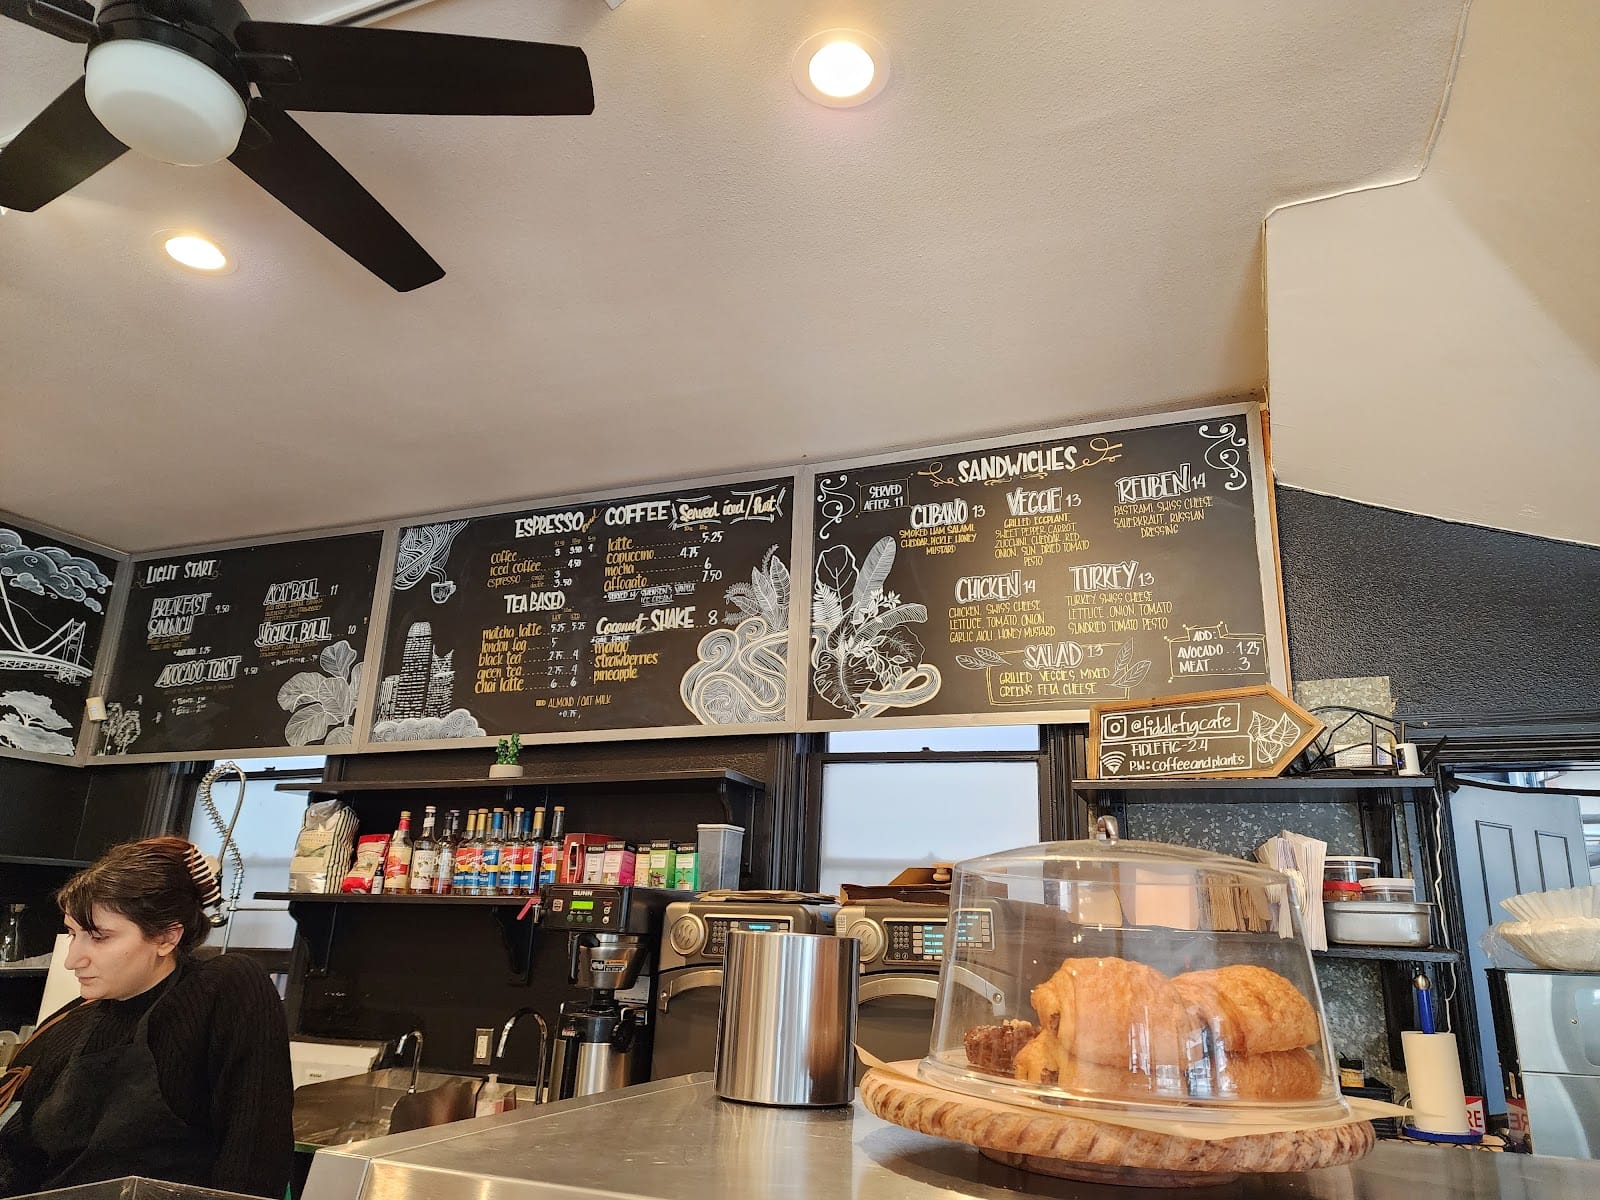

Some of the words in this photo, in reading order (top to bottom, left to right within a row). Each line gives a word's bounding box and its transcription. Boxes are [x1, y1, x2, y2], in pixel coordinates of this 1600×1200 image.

[957, 446, 1078, 484] SANDWICHES
[869, 484, 902, 499] SERVED
[1115, 463, 1191, 504] REUBEN
[1191, 472, 1206, 490] 14
[863, 498, 891, 511] AFTER
[894, 496, 904, 507] 11
[1006, 487, 1063, 516] VEGGIE
[1065, 493, 1082, 507] 13
[1156, 499, 1182, 512] SWISS
[1184, 496, 1214, 509] CHEESE
[605, 500, 671, 526] COFFEE
[678, 501, 721, 522] Served
[910, 498, 968, 529] CUBANO
[972, 504, 986, 518] 13
[1169, 509, 1205, 523] RUSSIAN
[515, 511, 585, 538] ESPRESSO
[1003, 517, 1032, 529] GRILLED
[1140, 524, 1179, 538] DRESSING
[899, 528, 928, 539] SMOKED
[929, 526, 946, 536] HAM
[930, 535, 952, 546] PICKLE
[955, 533, 977, 544] HONEY
[995, 528, 1019, 539] SWEET
[1065, 532, 1080, 542] RED
[588, 543, 594, 553] 4
[608, 538, 634, 553] latte
[702, 531, 725, 544] 5.25
[926, 545, 957, 556] MUSTARD
[1021, 545, 1036, 557] SUN
[1041, 542, 1061, 555] DRIED
[1062, 539, 1090, 553] TOMATO
[490, 550, 518, 565] coffee
[680, 547, 700, 559] 4.75
[1023, 555, 1043, 567] PESTO
[146, 564, 181, 584] LIGHT
[183, 560, 217, 579] START
[489, 563, 509, 577] iced
[512, 560, 542, 575] coffee
[567, 559, 582, 569] 4.50
[604, 563, 635, 578] mocha
[704, 557, 712, 570] 6
[1069, 560, 1140, 592] TURKEY
[1138, 572, 1155, 586] 13
[487, 575, 521, 589] espresso
[553, 570, 561, 579] 3
[553, 578, 573, 588] 3.50
[603, 573, 648, 593] affogato
[702, 569, 723, 583] 7.50
[955, 569, 1022, 604] CHICKEN
[1022, 579, 1036, 593] 14
[290, 578, 320, 601] BOWL
[330, 584, 339, 596] 11
[1099, 592, 1123, 604] SWISS
[1125, 591, 1153, 603] CHEESE
[151, 592, 213, 618] BREAKFAST
[503, 594, 528, 614] TEA
[529, 590, 566, 612] BASED
[985, 602, 1011, 614] SWISS
[1013, 600, 1041, 611] CHEESE
[1139, 600, 1173, 616] TOMATO
[595, 613, 650, 635] Coconut
[650, 606, 696, 632] SHAKE
[708, 609, 718, 625] 8
[1021, 611, 1045, 626] ONION
[1068, 620, 1107, 635] SUNDRIED
[1109, 618, 1138, 632] TOMATO
[1142, 617, 1168, 631] PESTO
[254, 622, 298, 647] YOGURT
[298, 616, 332, 643] BOWL
[347, 624, 357, 635] 10
[482, 625, 515, 640] matcha
[518, 622, 543, 638] latte
[949, 630, 974, 643] GARLIC
[998, 628, 1022, 640] HONEY
[1023, 625, 1056, 638] MUSTARD
[1193, 630, 1217, 642] ADD:
[481, 639, 509, 653] london
[511, 636, 528, 654] fog
[594, 641, 629, 656] mango
[1177, 644, 1224, 659] AVOCADO
[1236, 641, 1262, 656] 1.25
[478, 653, 503, 667] black
[506, 650, 522, 665] tea
[572, 648, 579, 660] 4
[594, 652, 658, 669] strawberries
[1023, 641, 1083, 670] SALAD
[1179, 659, 1211, 673] MEAT
[1239, 656, 1251, 671] 3
[154, 659, 206, 688] AVOCADO
[204, 655, 242, 681] TOAST
[476, 667, 502, 680] green
[506, 665, 522, 679] tea
[571, 663, 578, 675] 4
[593, 667, 638, 684] pineapple
[999, 671, 1033, 684] GRILLED
[1080, 667, 1110, 680] MIXED
[474, 678, 497, 694] chai
[500, 677, 525, 692] latte
[550, 679, 558, 689] 6
[569, 676, 577, 687] 6
[1037, 683, 1060, 696] FETA
[1062, 682, 1099, 695] CHEESE
[547, 696, 574, 708] ALMOND
[595, 694, 612, 705] MILK
[1130, 706, 1232, 737] @fiddlefigcafe
